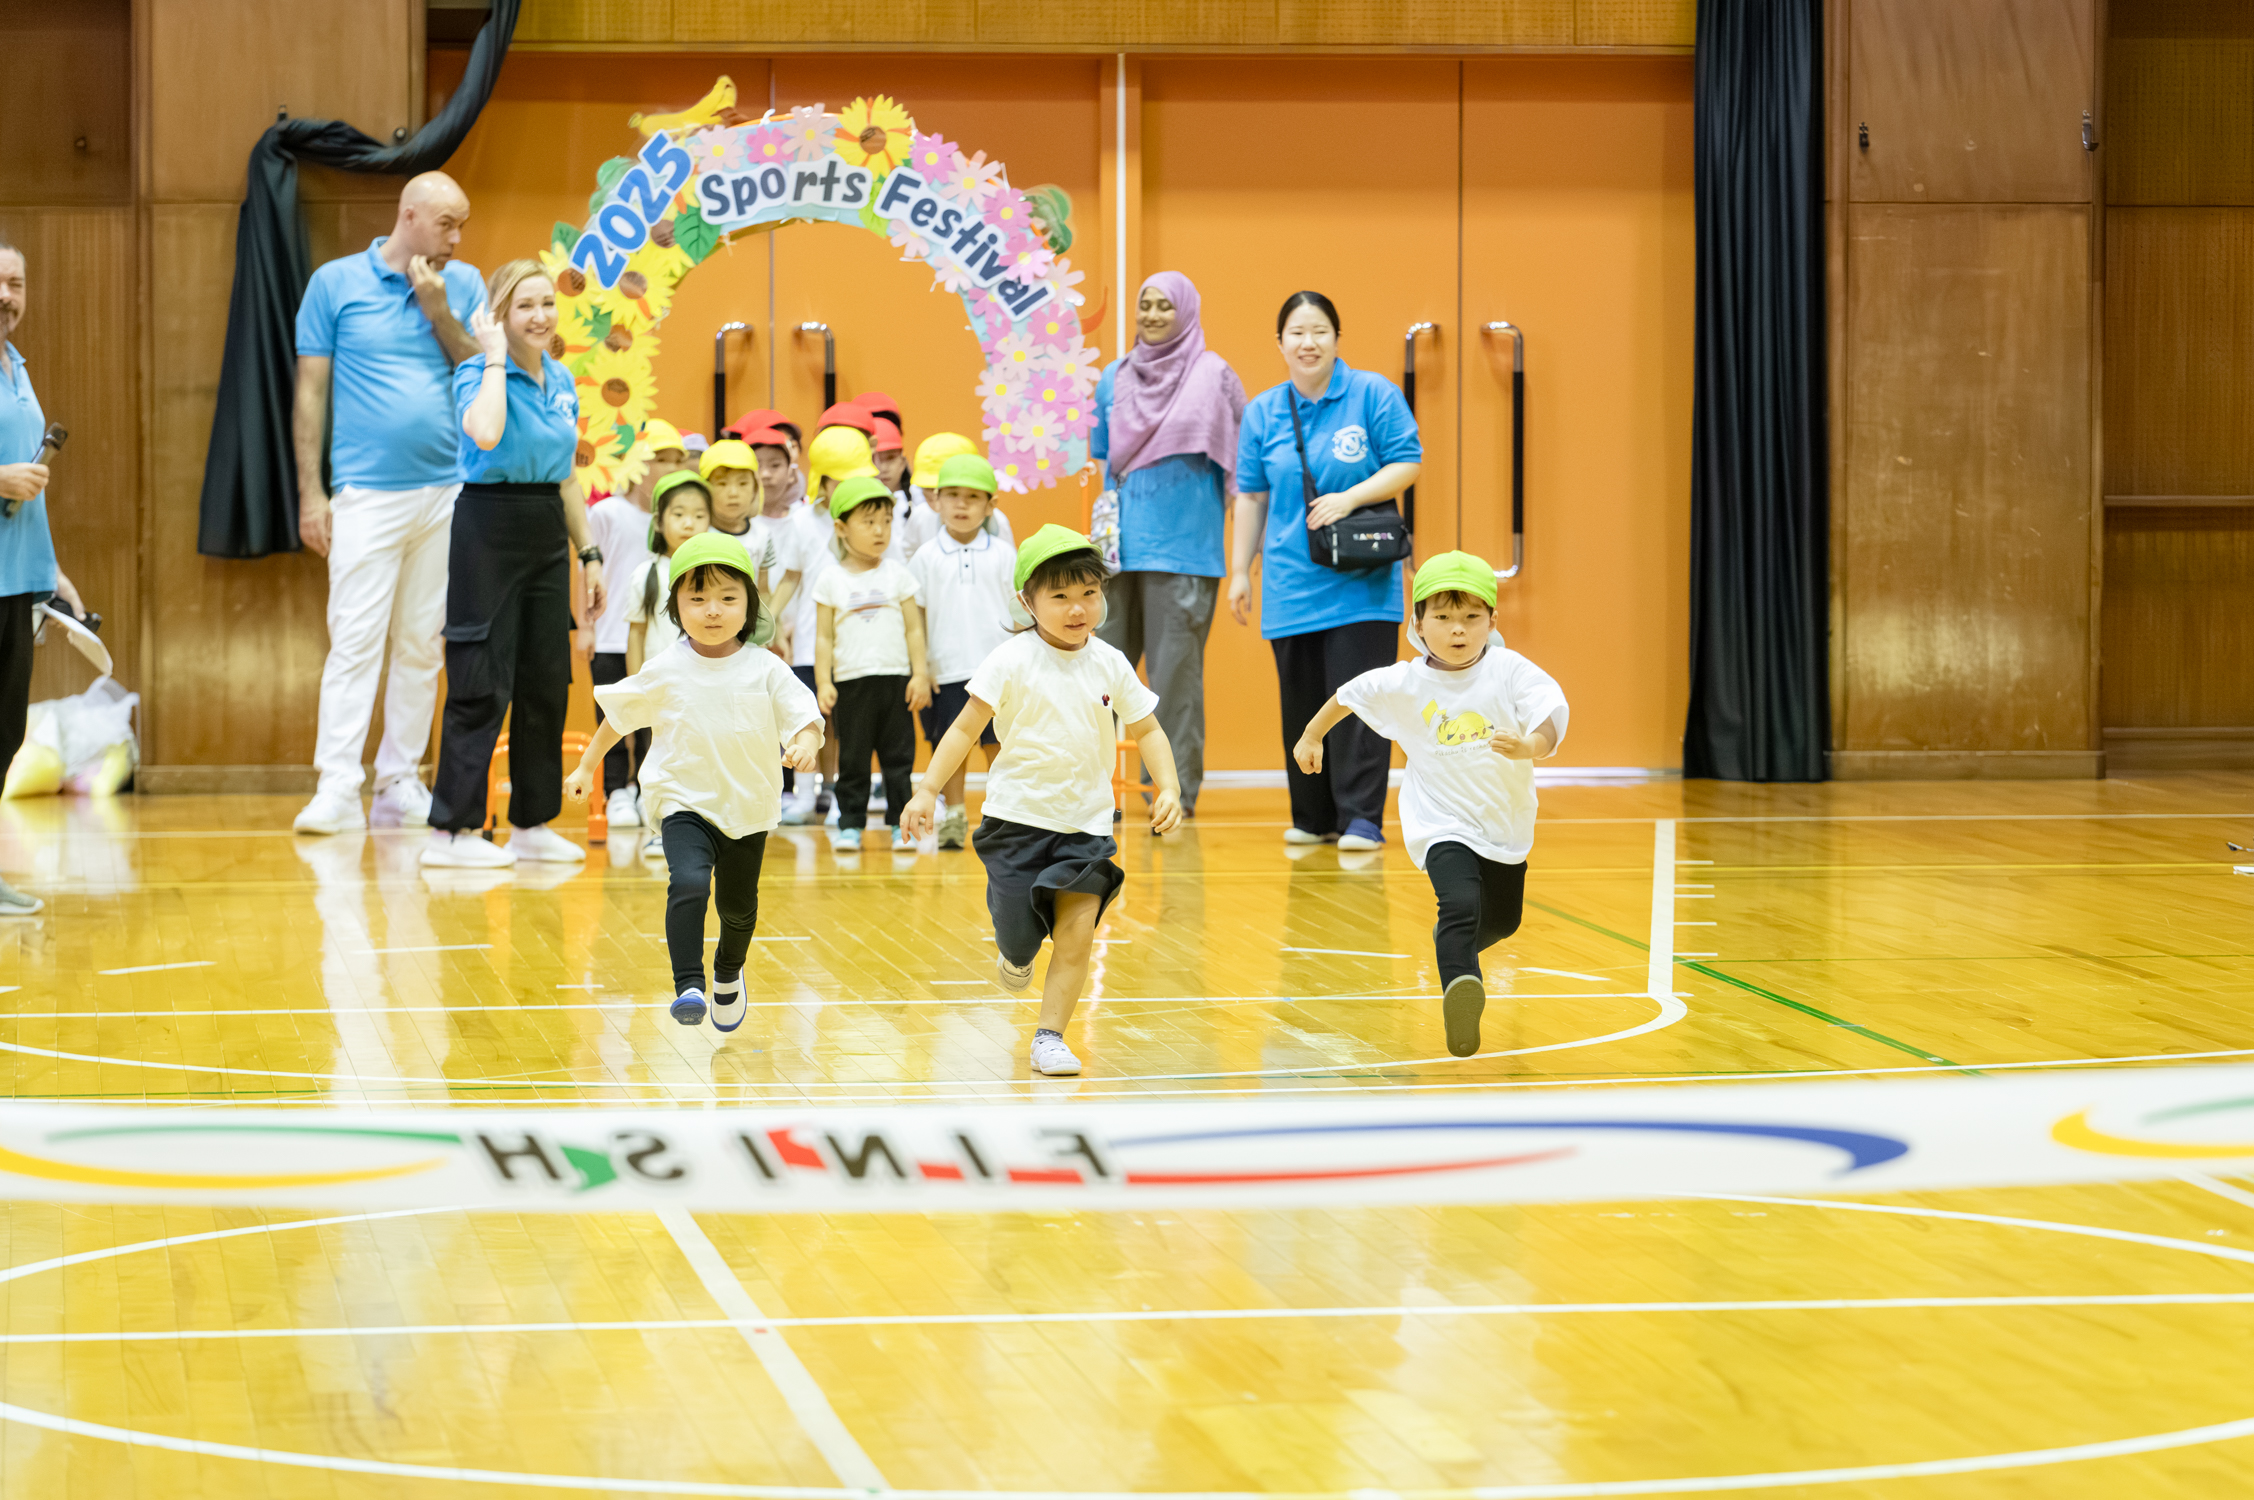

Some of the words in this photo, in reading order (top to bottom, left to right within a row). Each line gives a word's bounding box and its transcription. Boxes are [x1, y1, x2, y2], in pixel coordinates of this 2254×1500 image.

[572, 133, 691, 288] 2025
[702, 161, 867, 217] Sports
[880, 173, 1049, 316] Festival
